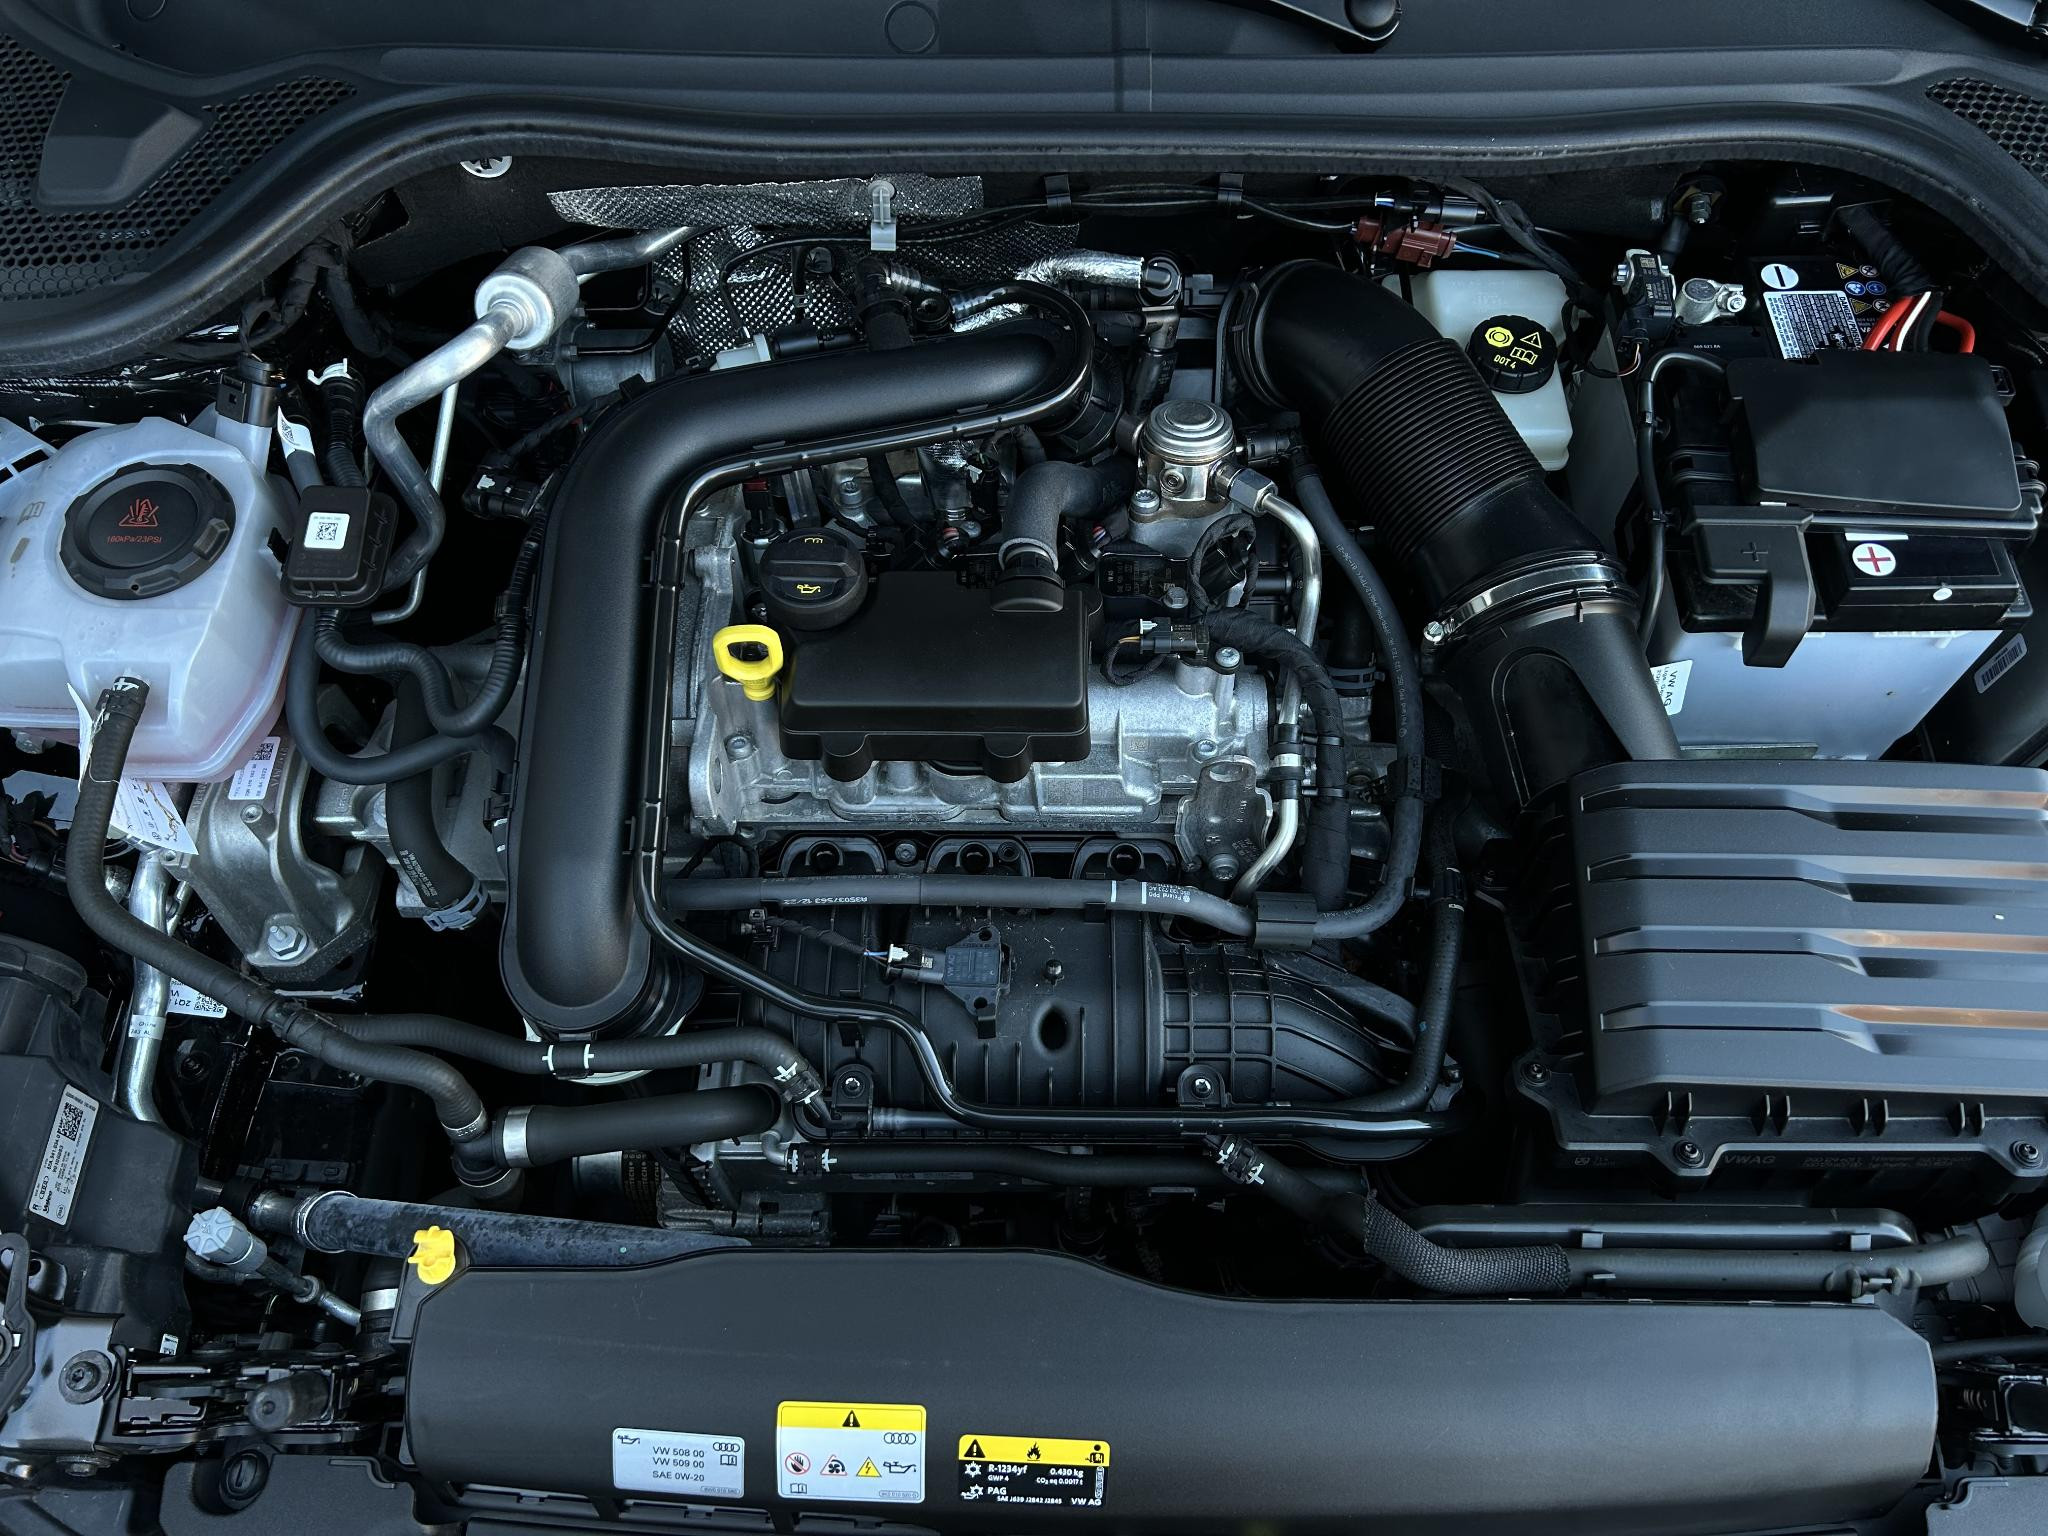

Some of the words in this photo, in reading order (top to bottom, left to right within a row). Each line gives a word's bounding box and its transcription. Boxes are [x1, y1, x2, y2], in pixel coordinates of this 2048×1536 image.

[1493, 354, 1511, 367] DOT
[1510, 361, 1517, 369] 4
[1668, 671, 1677, 687] VW
[1664, 692, 1672, 706] AG
[653, 1446, 670, 1455] VW
[673, 1448, 690, 1456] 508
[693, 1450, 705, 1458] 00
[653, 1457, 670, 1466] VW
[673, 1459, 690, 1467] 509
[693, 1460, 705, 1469] 00
[653, 1471, 672, 1479] SAE
[675, 1472, 705, 1482] 0W-20
[988, 1464, 1028, 1476] R-1234yf
[1050, 1468, 1072, 1476] 0.430
[1073, 1469, 1084, 1478] kg
[1050, 1478, 1057, 1486] eq
[987, 1487, 1007, 1495] PAG
[1071, 1497, 1087, 1505] VW
[1087, 1498, 1102, 1506] AG
